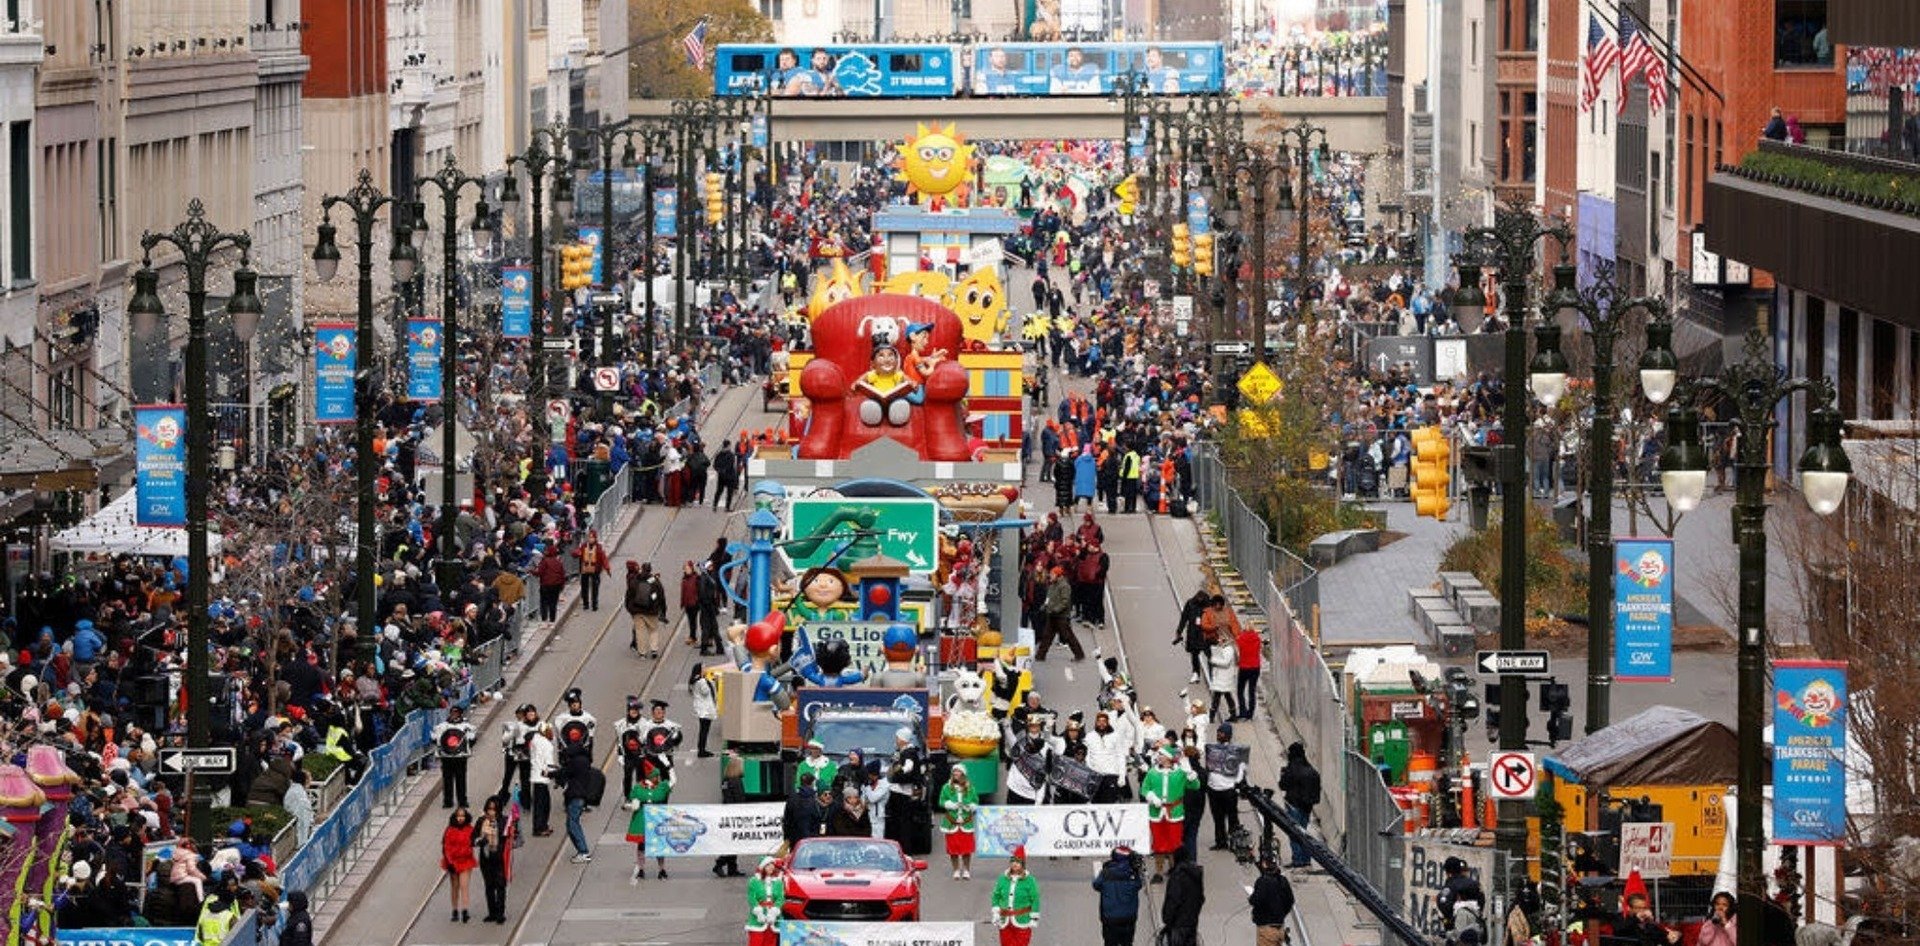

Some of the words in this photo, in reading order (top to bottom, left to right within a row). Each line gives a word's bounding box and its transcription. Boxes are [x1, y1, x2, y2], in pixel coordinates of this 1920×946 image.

[888, 528, 918, 544] Fwy
[817, 627, 844, 641] Go
[851, 627, 887, 641] Lio
[1520, 657, 1541, 668] WAY
[1775, 746, 1845, 760] THANKSGIVING
[204, 756, 225, 767] WAY
[1791, 759, 1828, 771] PARADE
[1786, 774, 1832, 783] DETROIT
[1794, 808, 1821, 822] GW
[1063, 809, 1127, 838] GW
[731, 830, 783, 841] PARALYMP
[1053, 840, 1101, 850] GARDNER
